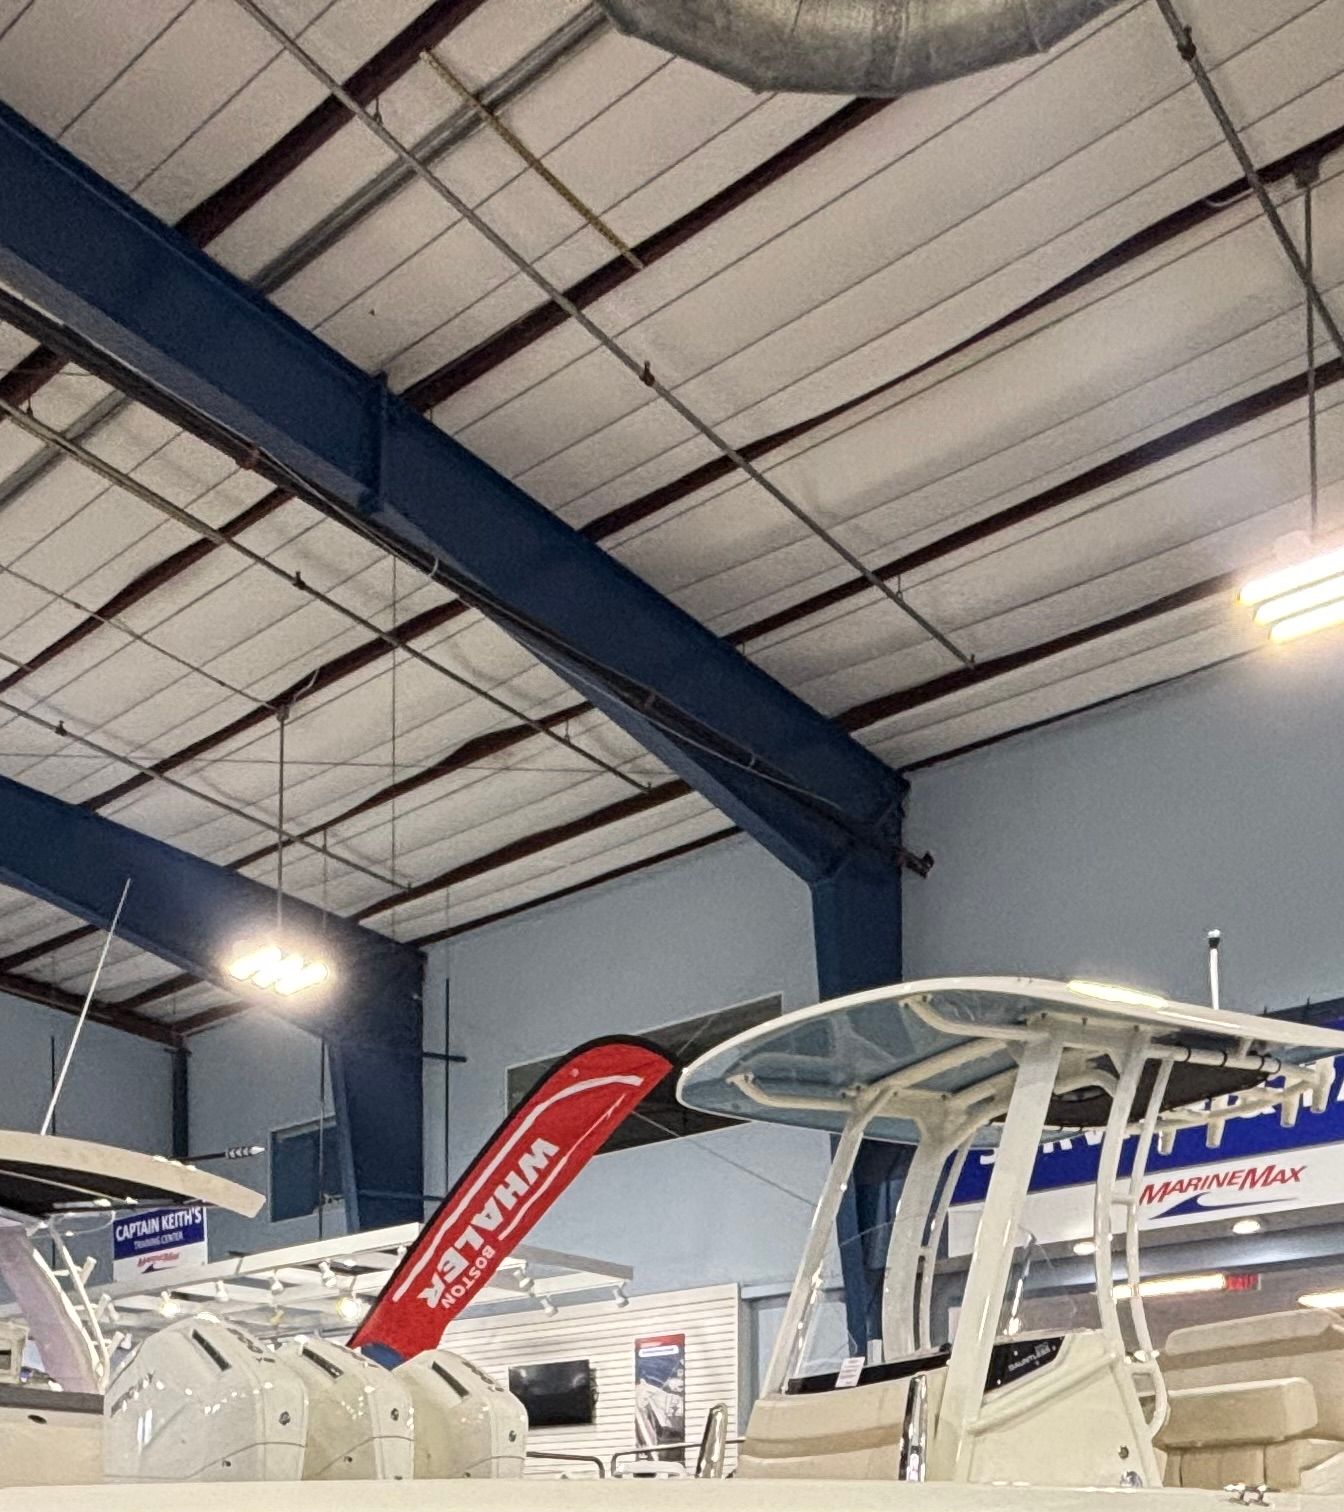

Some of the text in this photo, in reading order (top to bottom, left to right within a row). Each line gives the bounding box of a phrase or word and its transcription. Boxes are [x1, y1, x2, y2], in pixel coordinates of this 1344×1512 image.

[116, 1206, 203, 1242] CAPTAIN KEITH'S
[417, 1137, 560, 1309] WHALER
[440, 1245, 496, 1308] BOSTON
